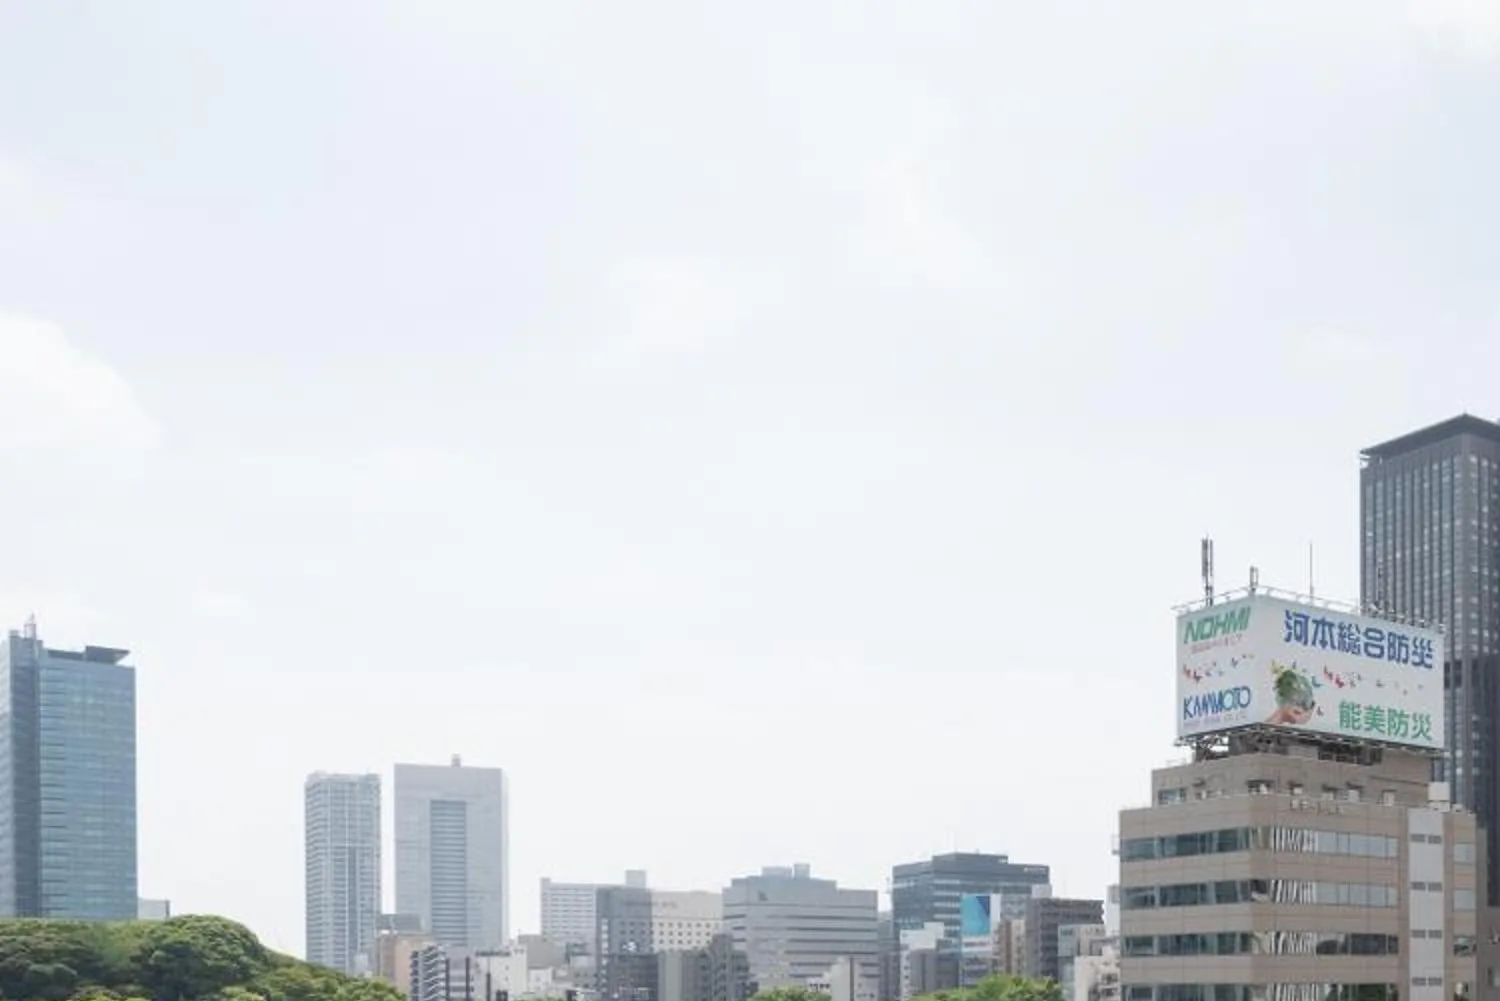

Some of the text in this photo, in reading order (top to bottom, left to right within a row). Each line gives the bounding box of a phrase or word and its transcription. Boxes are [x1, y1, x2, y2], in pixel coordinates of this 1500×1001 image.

[1184, 606, 1251, 644] NOHMI
[1284, 609, 1433, 669] 河本総合防災
[1338, 701, 1432, 741] 能美防災
